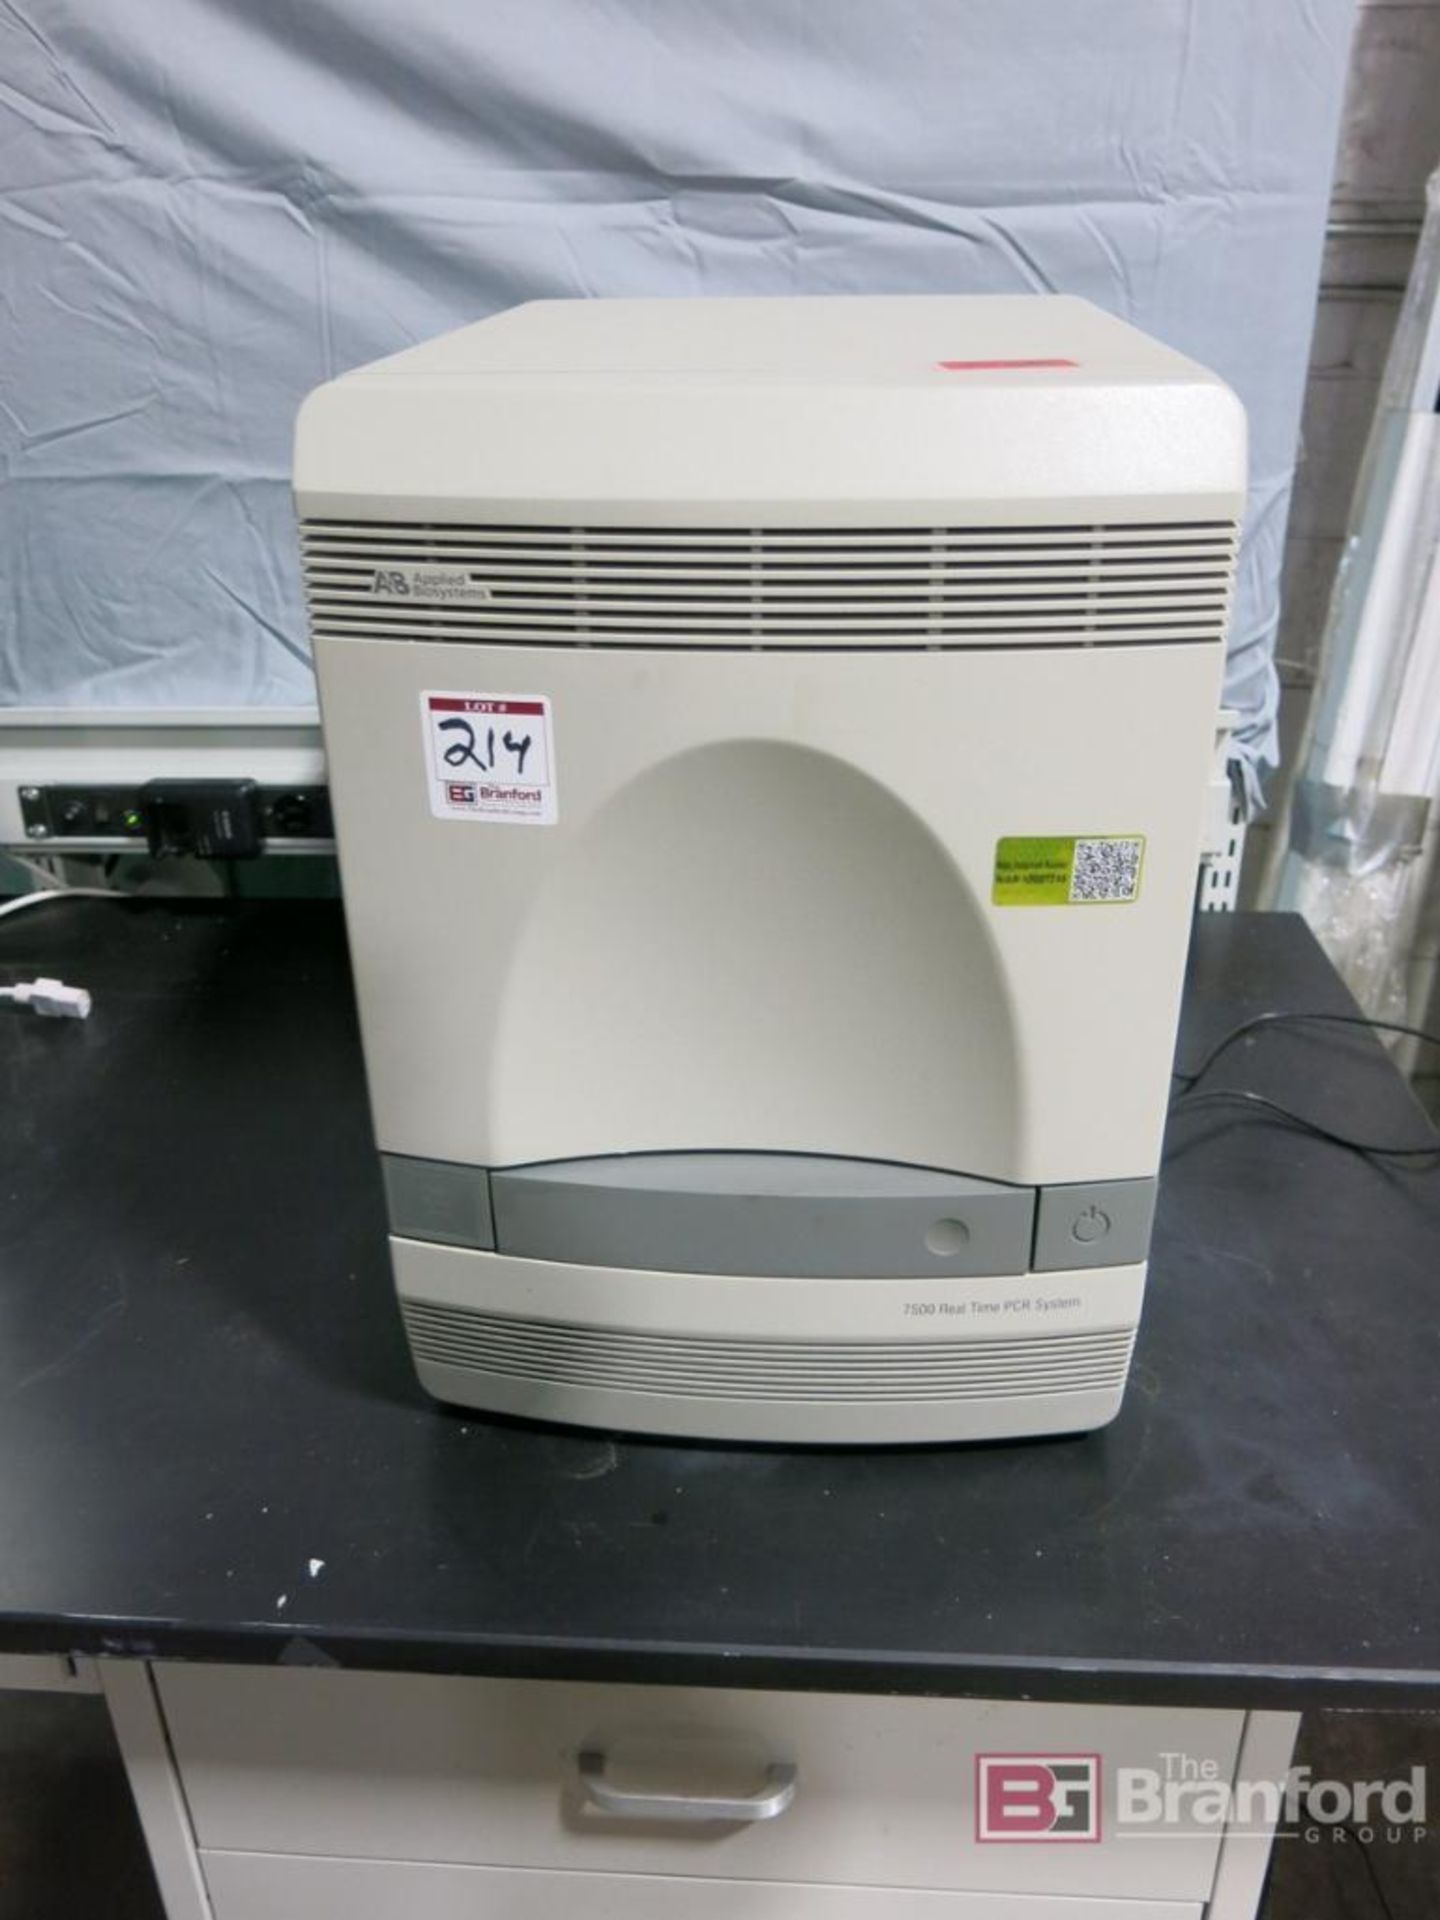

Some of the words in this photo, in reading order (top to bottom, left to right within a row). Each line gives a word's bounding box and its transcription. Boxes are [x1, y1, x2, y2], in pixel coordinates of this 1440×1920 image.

[464, 701, 495, 712] LOT
[438, 717, 531, 774] 214
[480, 786, 542, 802] Branford
[903, 1303, 935, 1316] 7500
[971, 1300, 999, 1313] Time
[1036, 1297, 1081, 1311] System
